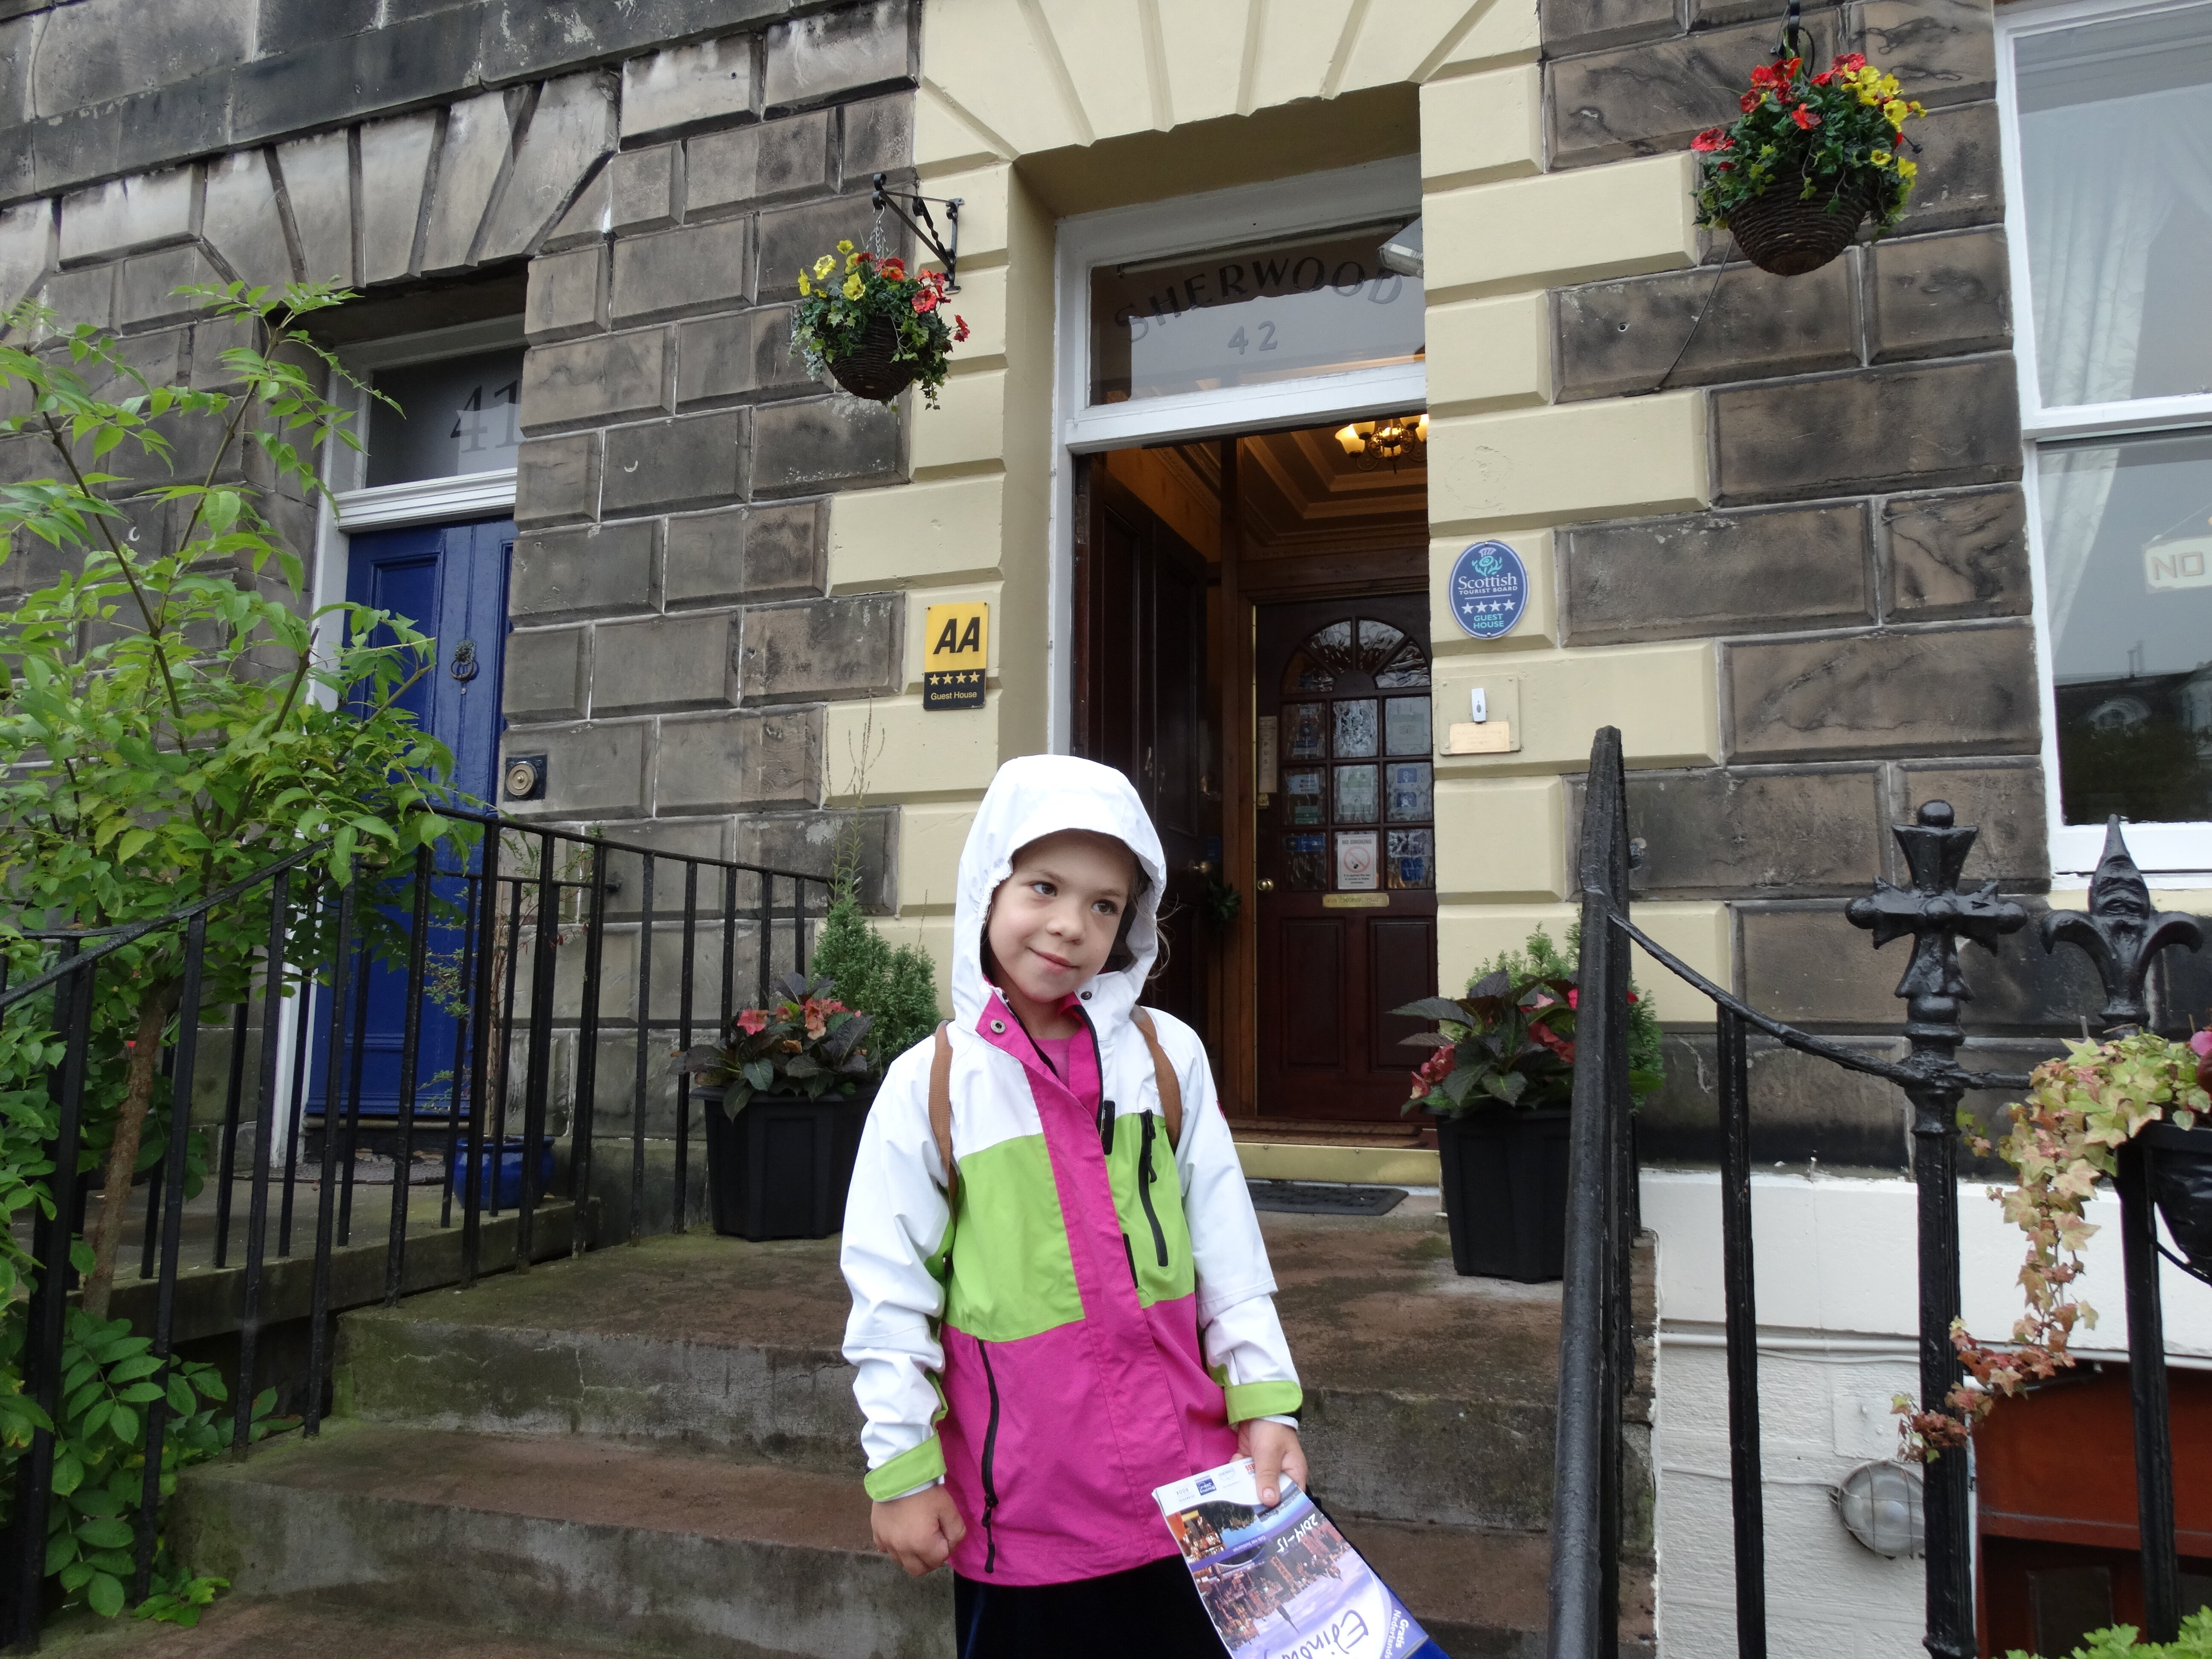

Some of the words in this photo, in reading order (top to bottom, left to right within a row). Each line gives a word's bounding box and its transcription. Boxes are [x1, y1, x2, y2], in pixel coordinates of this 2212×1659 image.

[1115, 256, 1403, 342] SHERWOOD
[1227, 320, 1278, 355] 42
[451, 379, 523, 454] 41
[1458, 573, 1517, 590] Scottish
[2151, 551, 2205, 580] NO
[1473, 613, 1503, 622] GUEST
[1473, 620, 1504, 629] HOUSE
[933, 617, 980, 655] AA
[931, 692, 952, 700] Guest
[1277, 1513, 1318, 1553] 2014-15
[1385, 1609, 1402, 1659] Nederlands
[1395, 1618, 1409, 1648] Gratis
